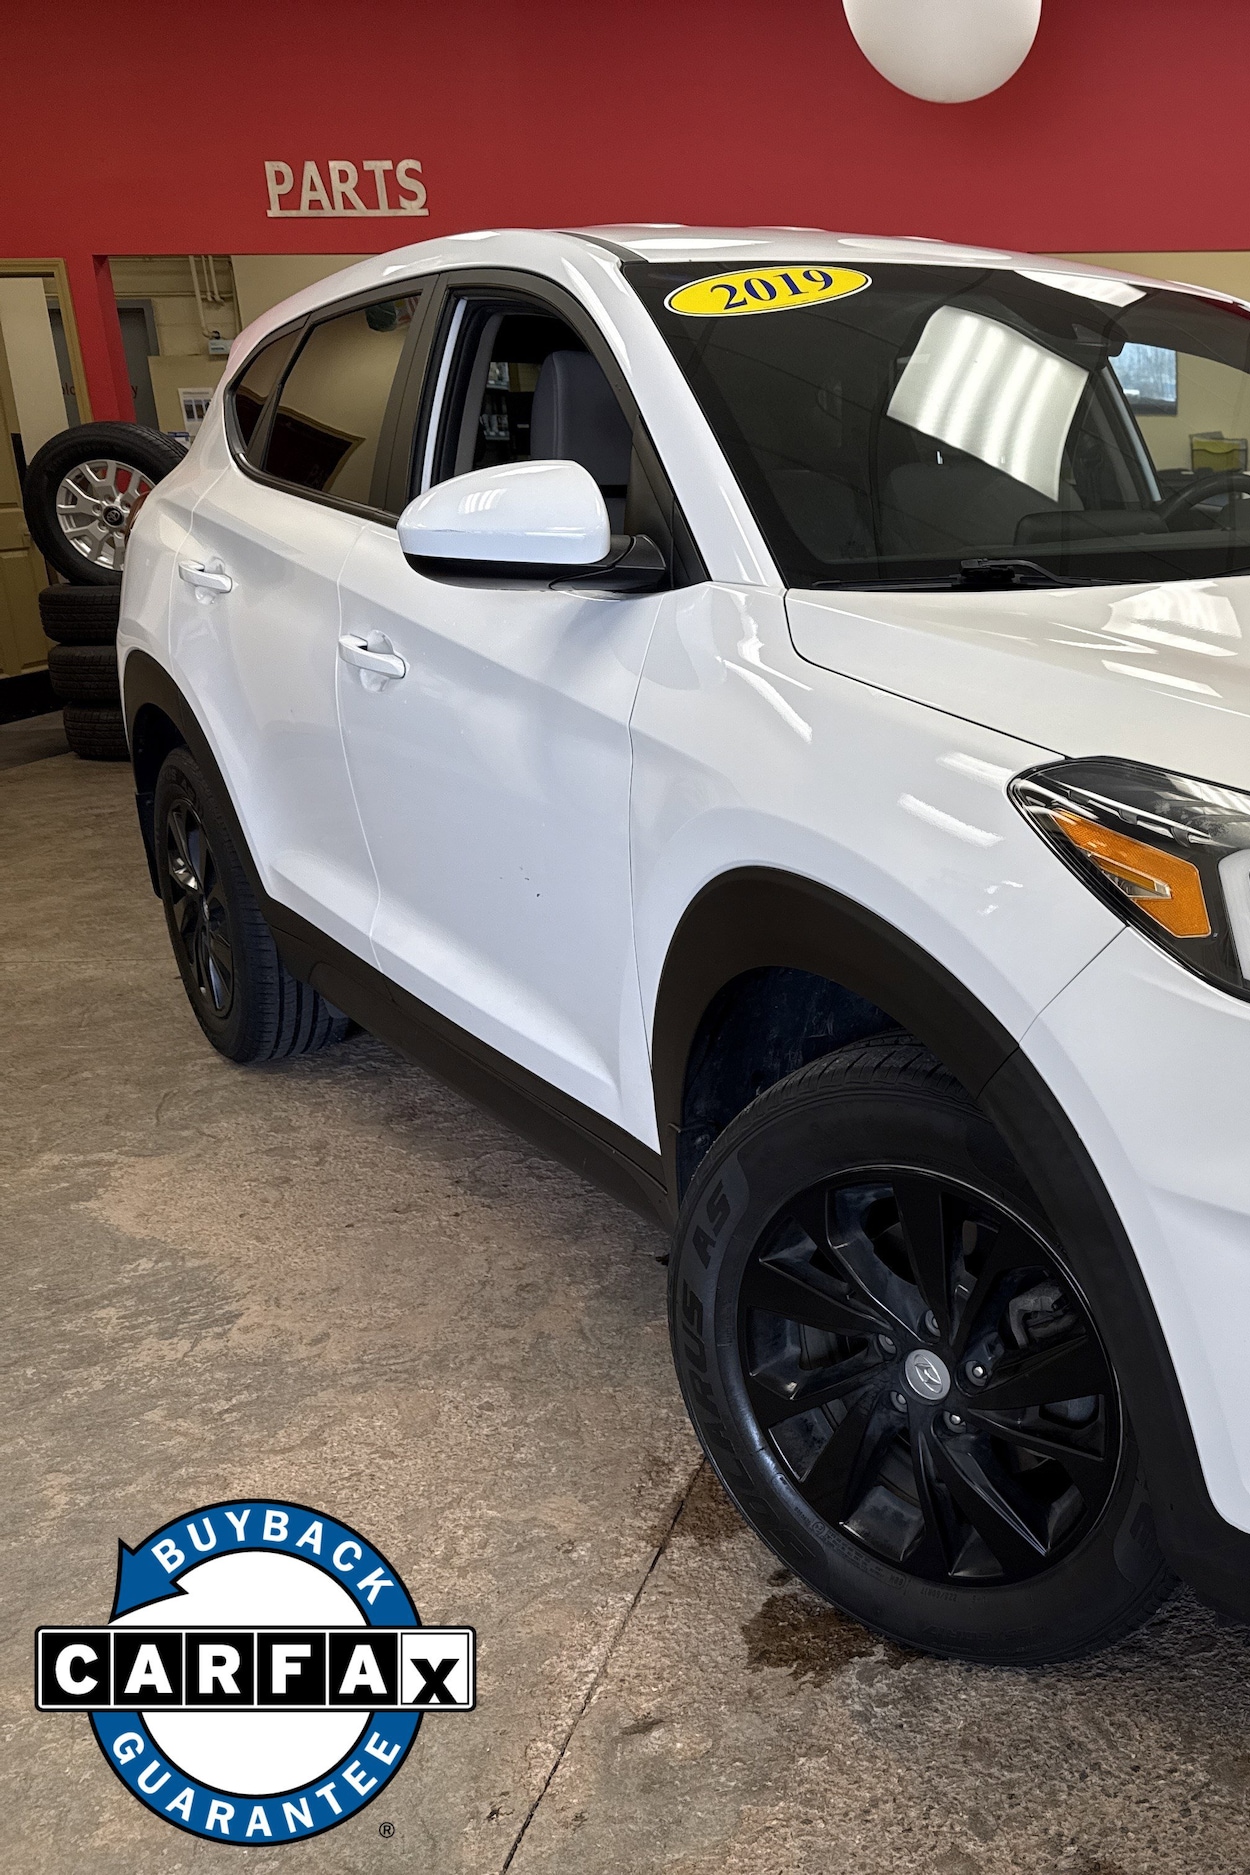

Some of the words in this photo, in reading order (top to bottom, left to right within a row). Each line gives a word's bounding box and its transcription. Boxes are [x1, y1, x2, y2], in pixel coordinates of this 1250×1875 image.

[264, 158, 428, 213] PARTS
[710, 269, 833, 311] 2019
[691, 1179, 730, 1270] AS
